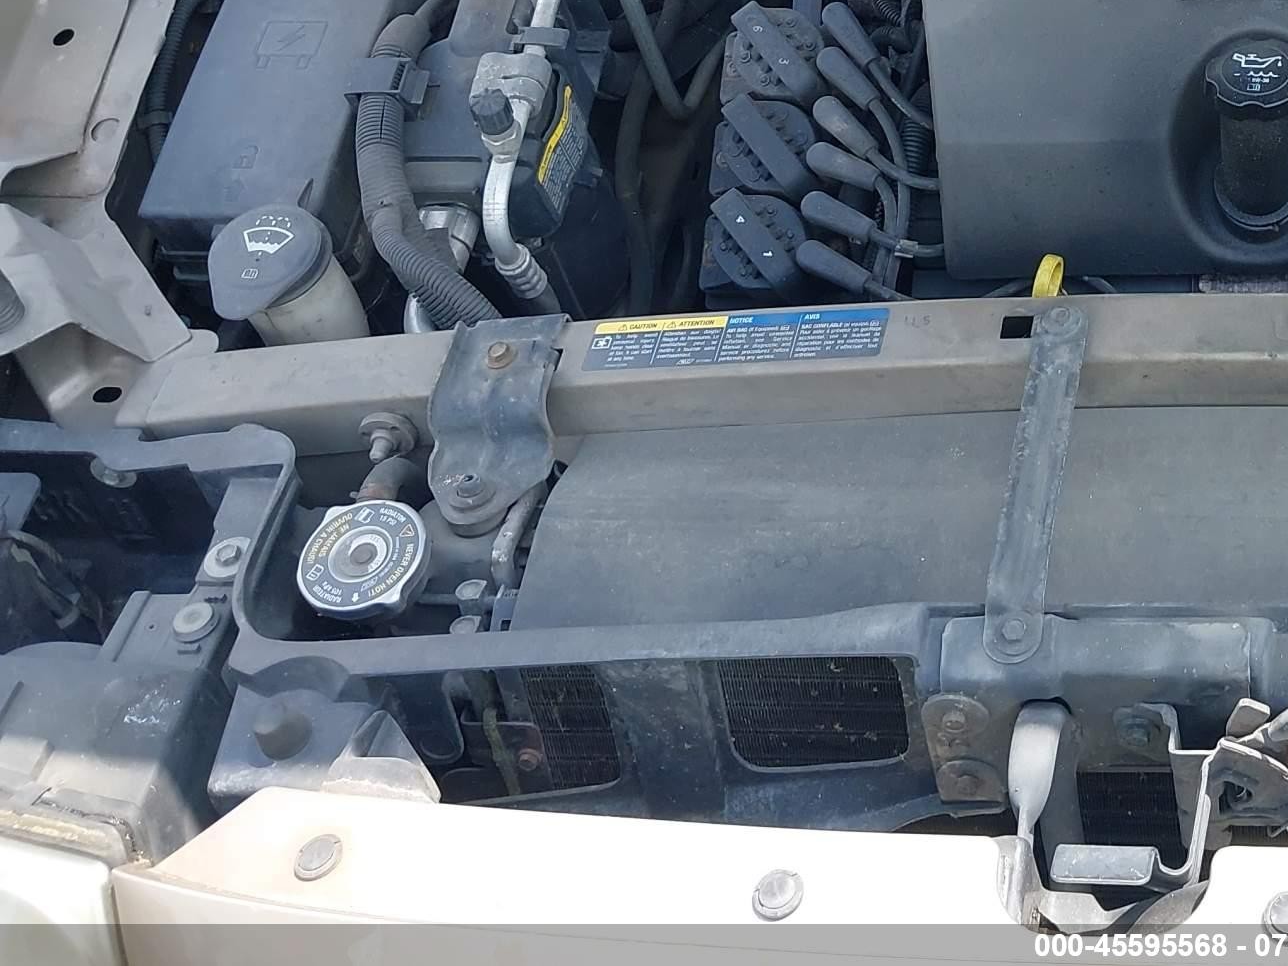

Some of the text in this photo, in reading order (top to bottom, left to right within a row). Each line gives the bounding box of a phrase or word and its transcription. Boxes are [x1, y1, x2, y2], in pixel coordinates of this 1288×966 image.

[735, 216, 745, 224] 4
[763, 250, 773, 258] 1
[680, 319, 714, 327] ATTENTION
[730, 316, 754, 324] NOTICE
[380, 507, 407, 523] RADIATOR
[387, 517, 398, 526] PSI
[325, 512, 353, 533] OUVRIR
[318, 532, 339, 558] JAMAIS
[401, 543, 415, 566] NEVER
[386, 566, 405, 586] OPEN
[367, 583, 387, 597] HOT!
